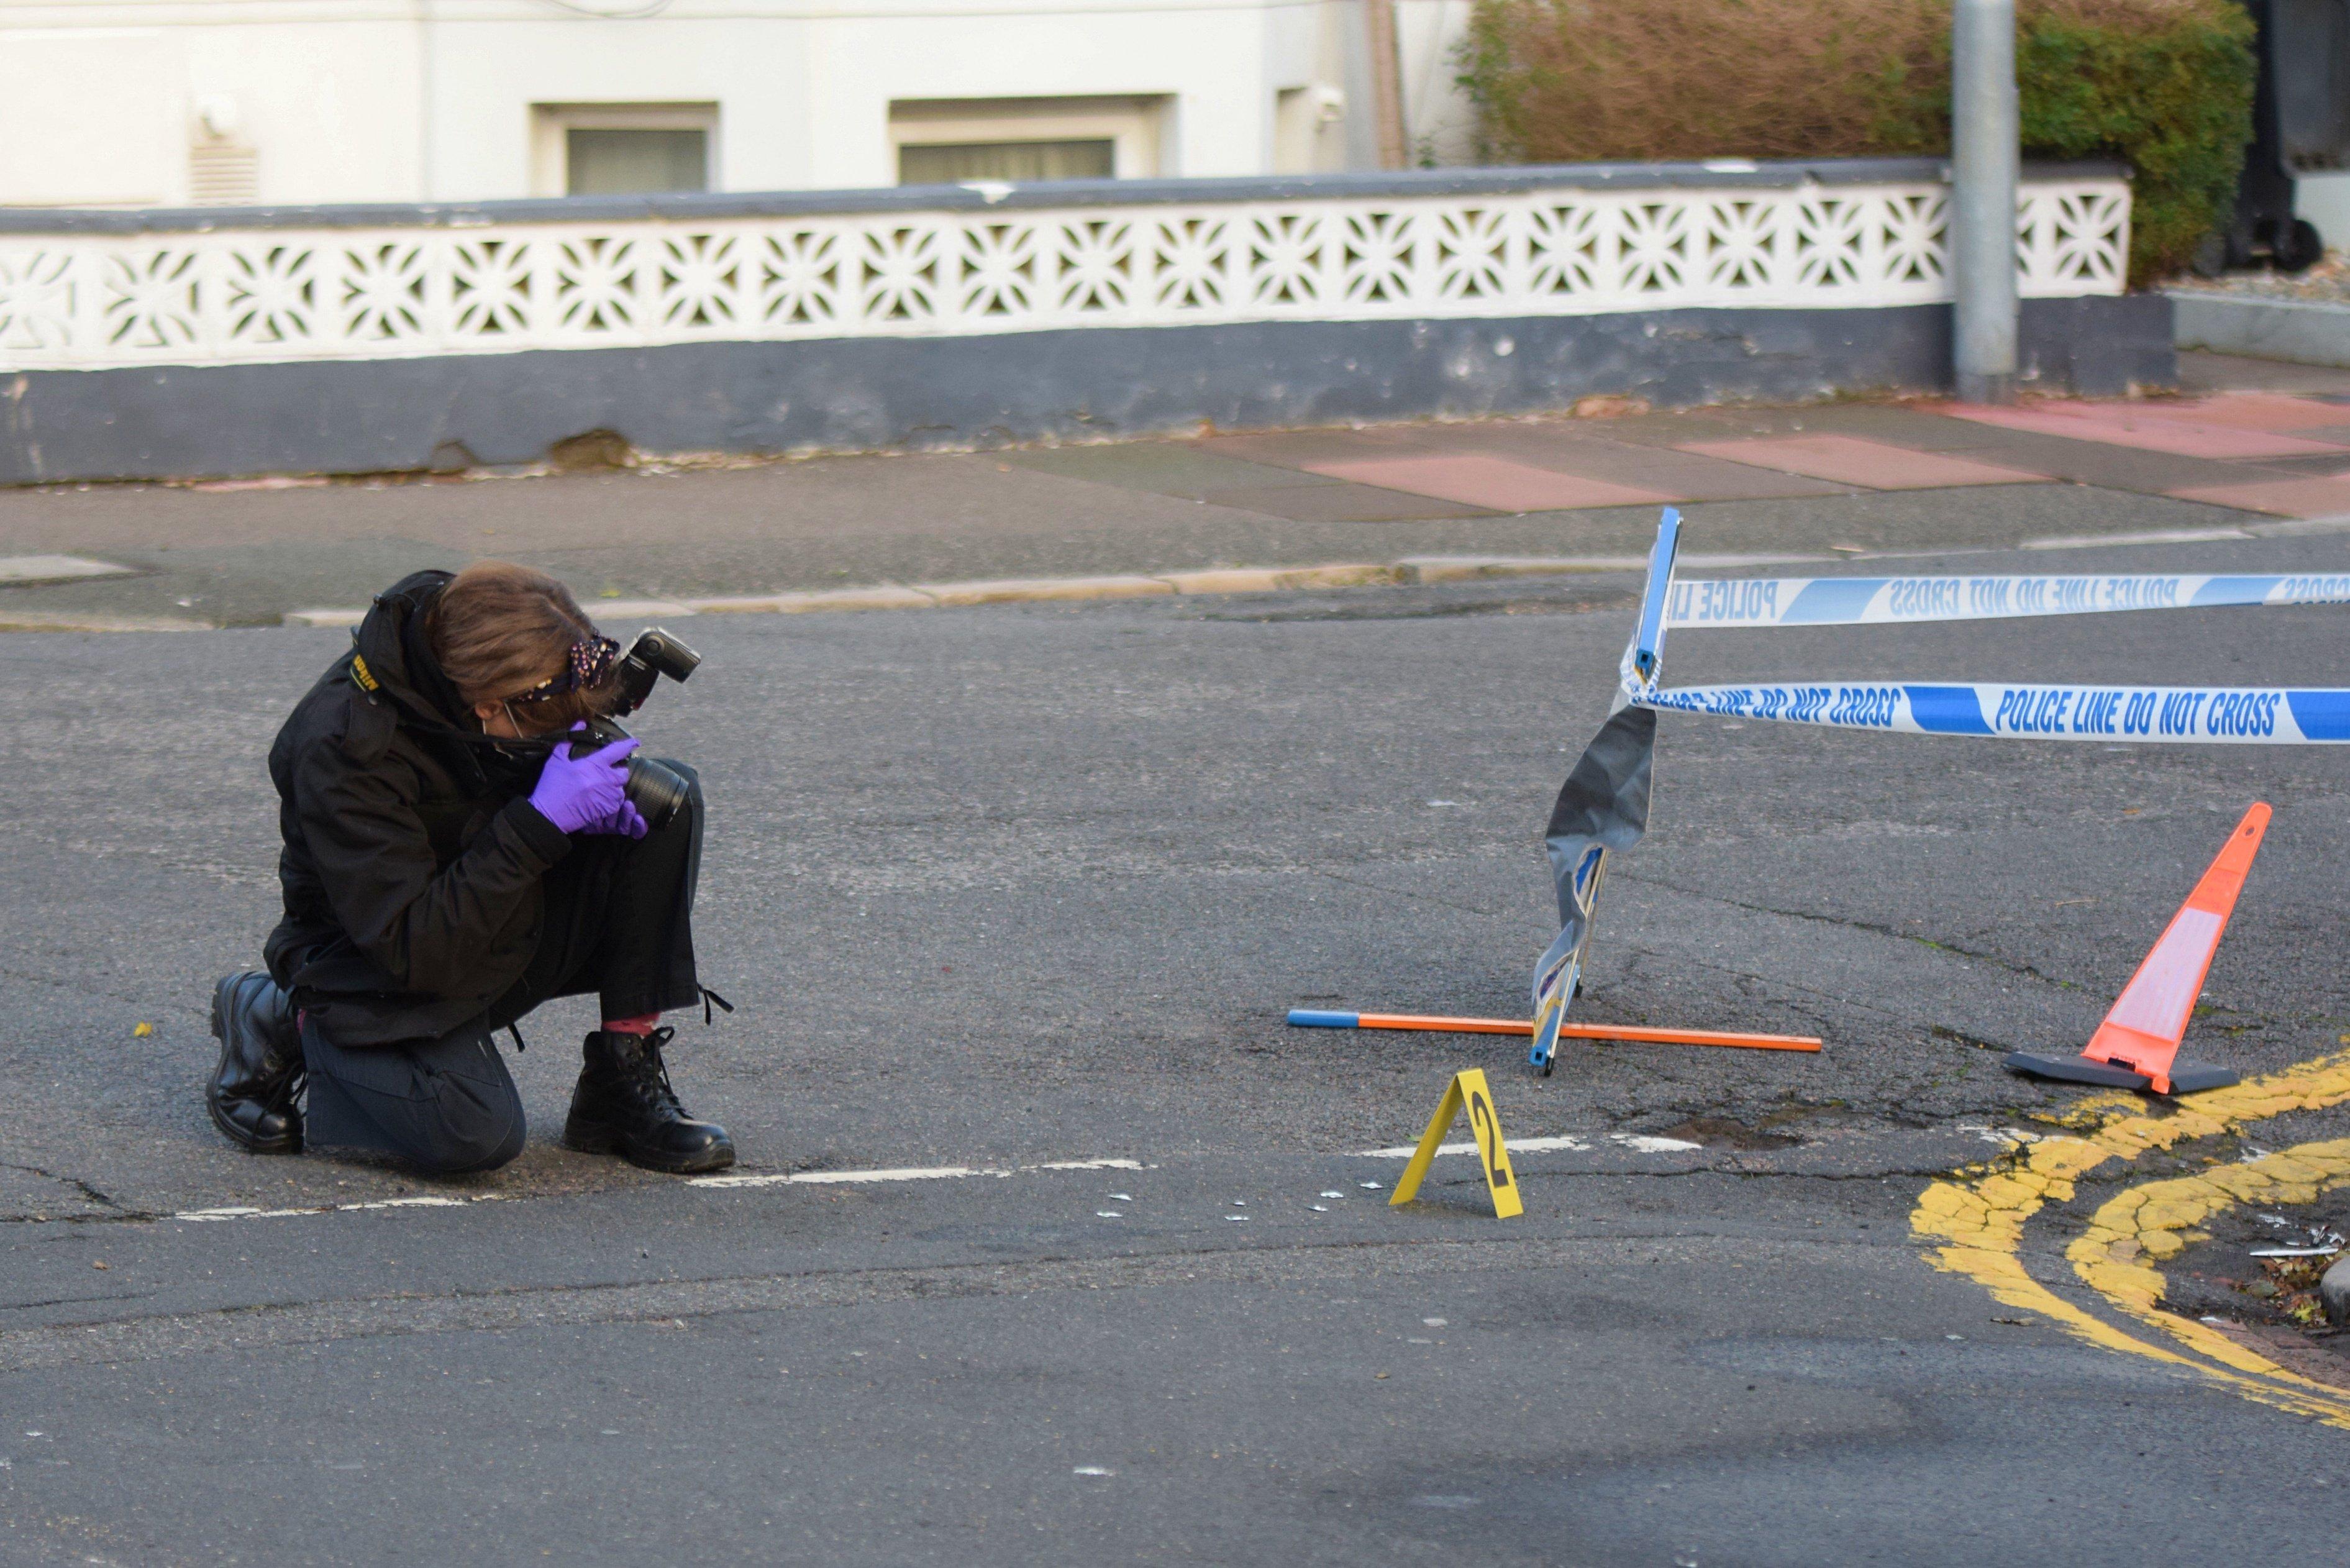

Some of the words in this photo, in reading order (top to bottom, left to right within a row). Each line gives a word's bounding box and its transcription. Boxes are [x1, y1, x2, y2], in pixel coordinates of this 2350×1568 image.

[1752, 689, 1788, 719] DO
[1785, 688, 1832, 722] NOT
[1829, 688, 1901, 727] CROSS
[1996, 690, 2073, 733] POLICE
[2073, 691, 2124, 734] LINE
[2123, 692, 2157, 735] DO
[2159, 692, 2208, 736] NOT
[2207, 693, 2281, 737] CROSS
[1472, 1091, 1509, 1188] 2
